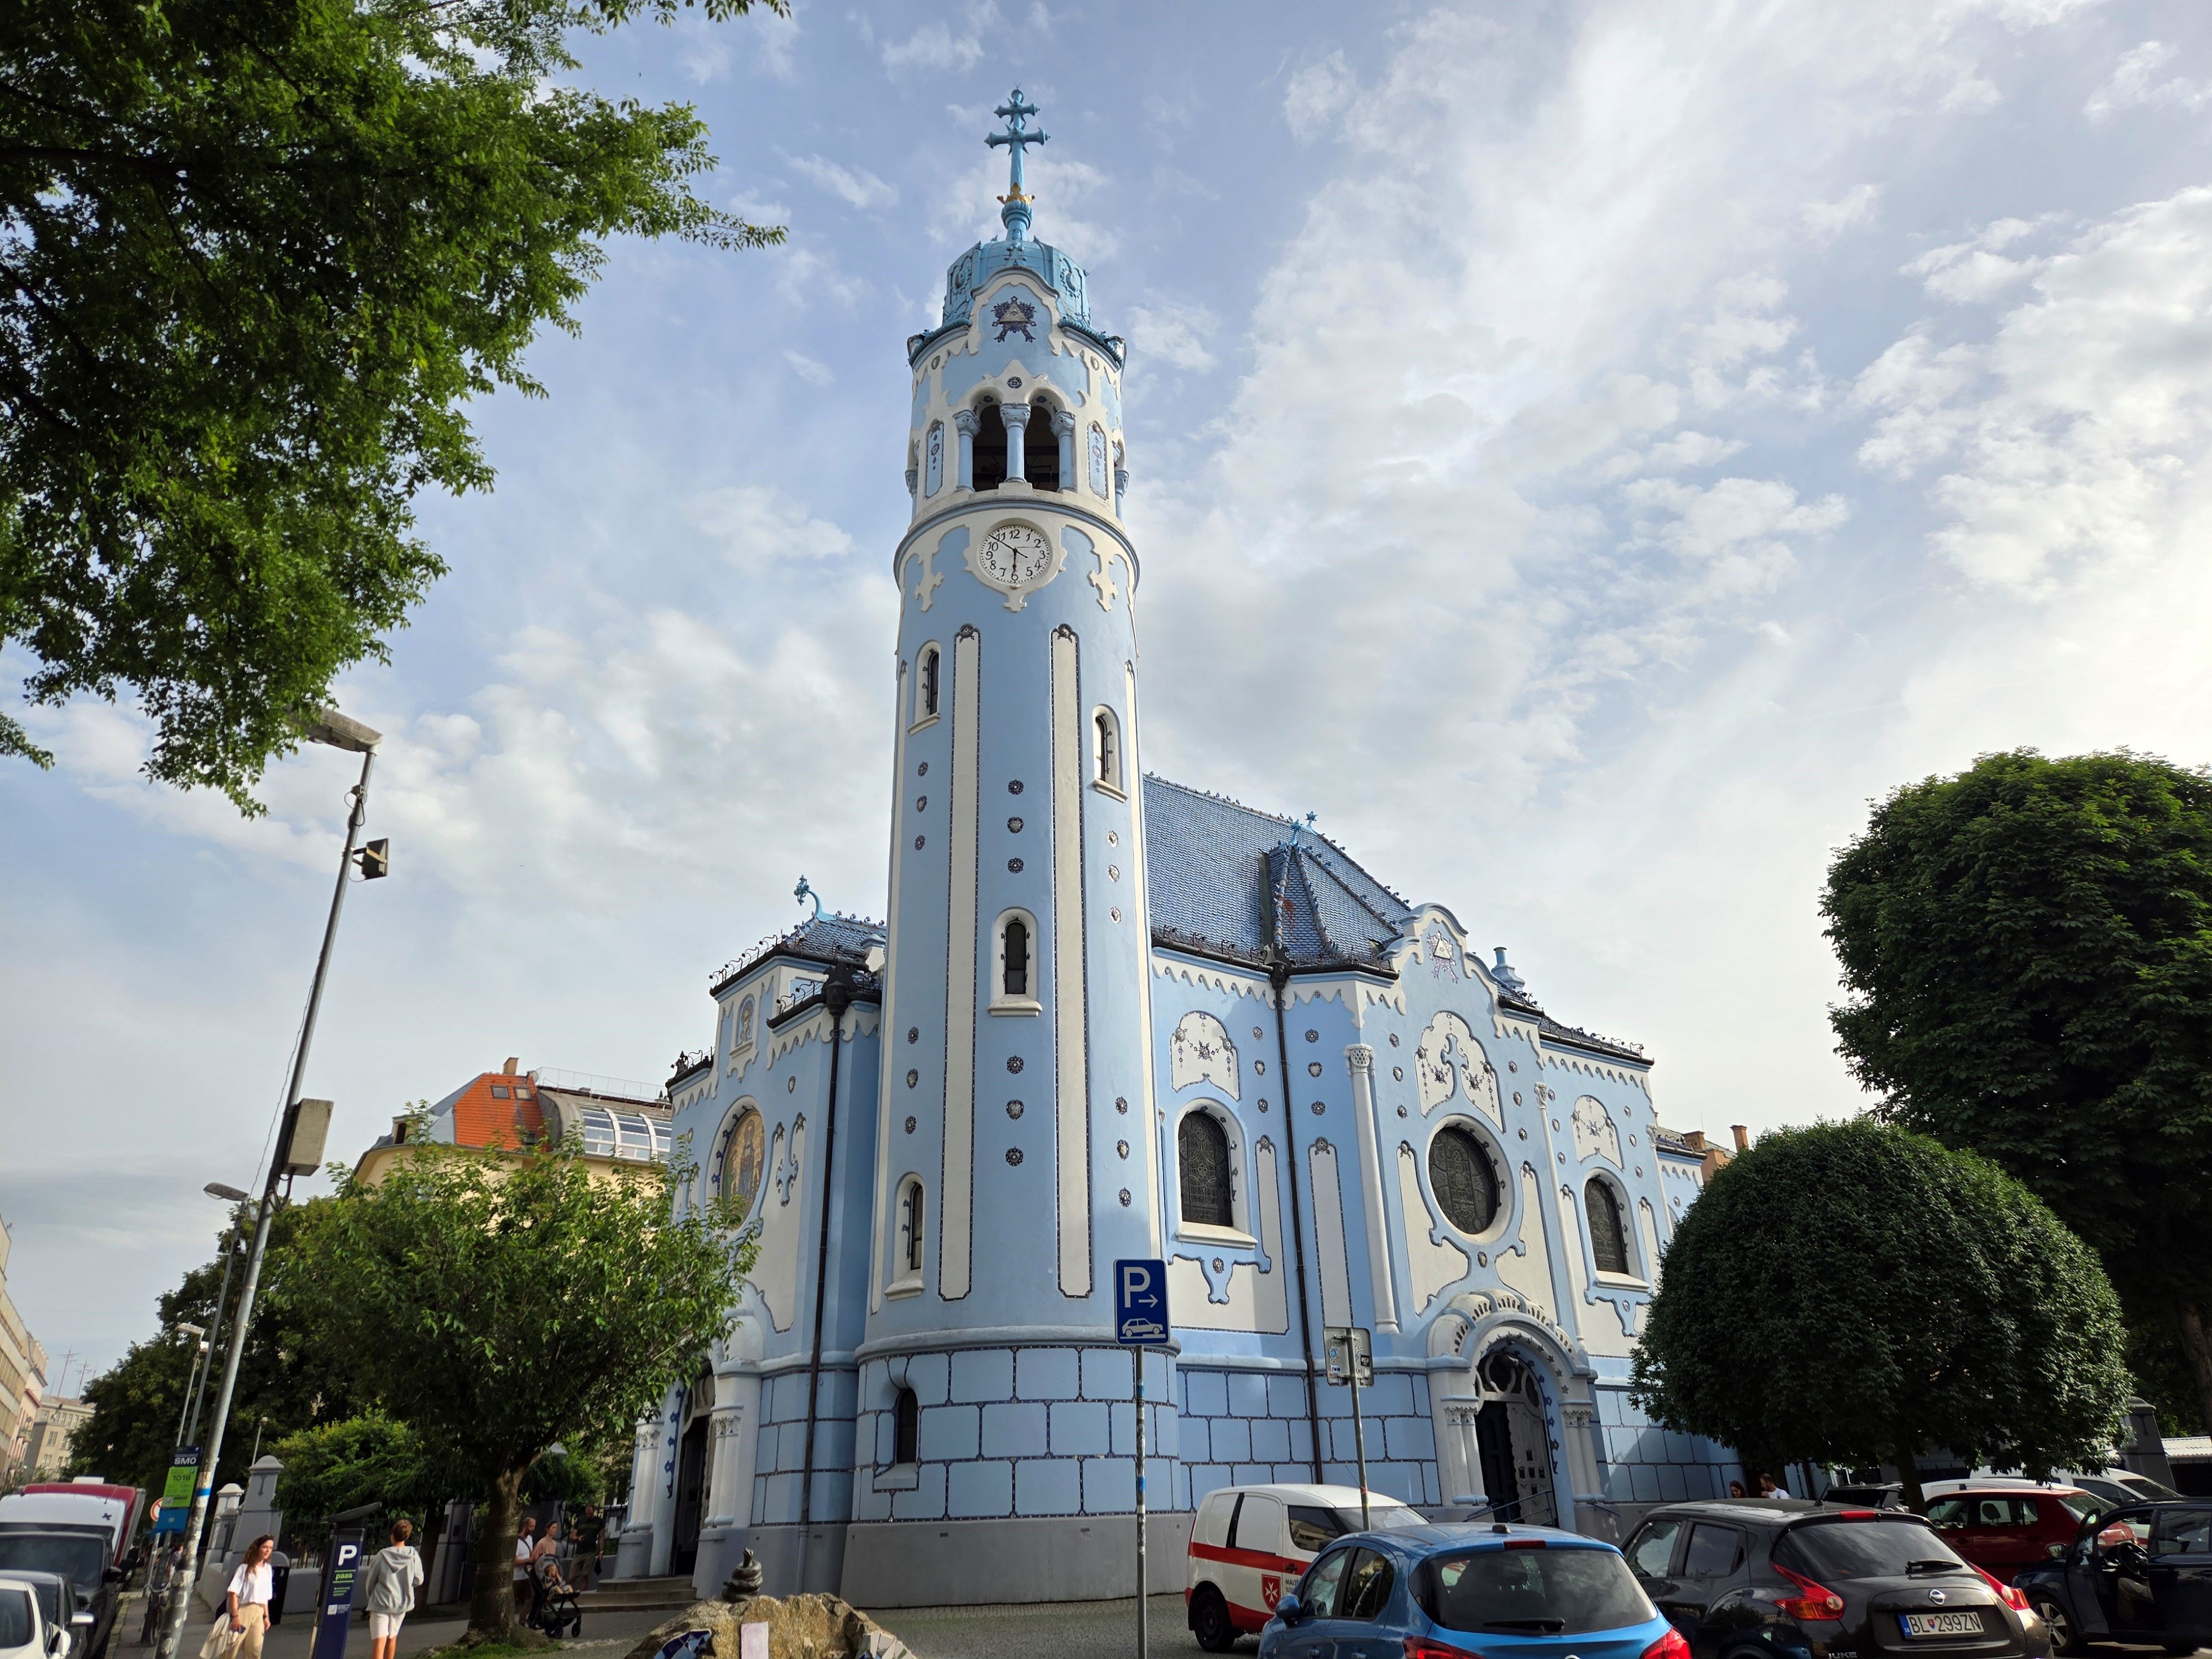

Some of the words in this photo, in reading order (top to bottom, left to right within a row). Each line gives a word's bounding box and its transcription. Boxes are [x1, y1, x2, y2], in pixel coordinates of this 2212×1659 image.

[995, 532, 1005, 541] 11
[1009, 529, 1020, 539] 12
[1026, 533, 1031, 541] 1
[988, 541, 998, 551] 10
[1034, 539, 1041, 548] 2
[985, 551, 993, 560] 9
[1039, 550, 1046, 560] 3
[990, 560, 996, 570] 8
[1034, 559, 1042, 571] 4
[999, 567, 1007, 577] 7
[1011, 571, 1019, 581] 6
[1026, 567, 1033, 576] 5
[1124, 1266, 1151, 1308] P
[338, 1545, 357, 1566] P
[1909, 1616, 1930, 1633] BL
[1934, 1614, 1981, 1632] 299ZN
